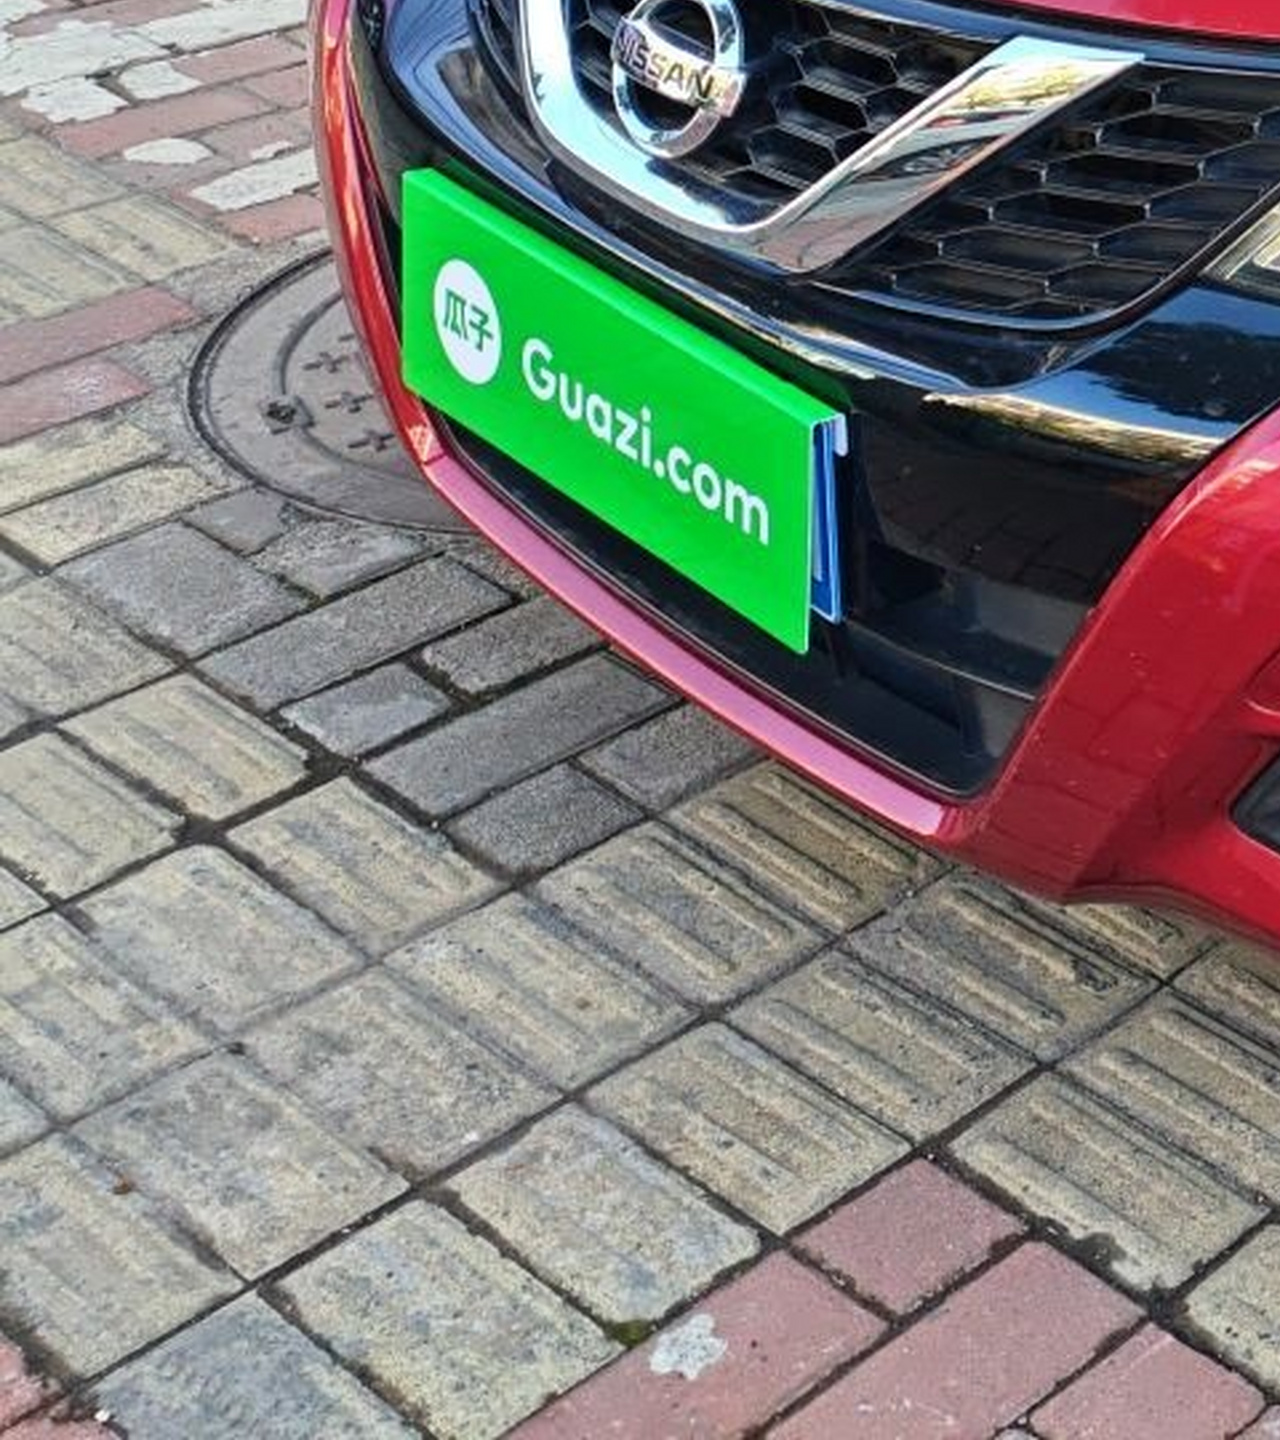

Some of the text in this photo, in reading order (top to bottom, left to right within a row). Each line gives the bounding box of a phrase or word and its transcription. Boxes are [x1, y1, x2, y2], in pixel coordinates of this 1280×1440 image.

[615, 26, 715, 100] NISSAN
[442, 286, 494, 355] 瓜子
[521, 337, 769, 546] Guazi.com
